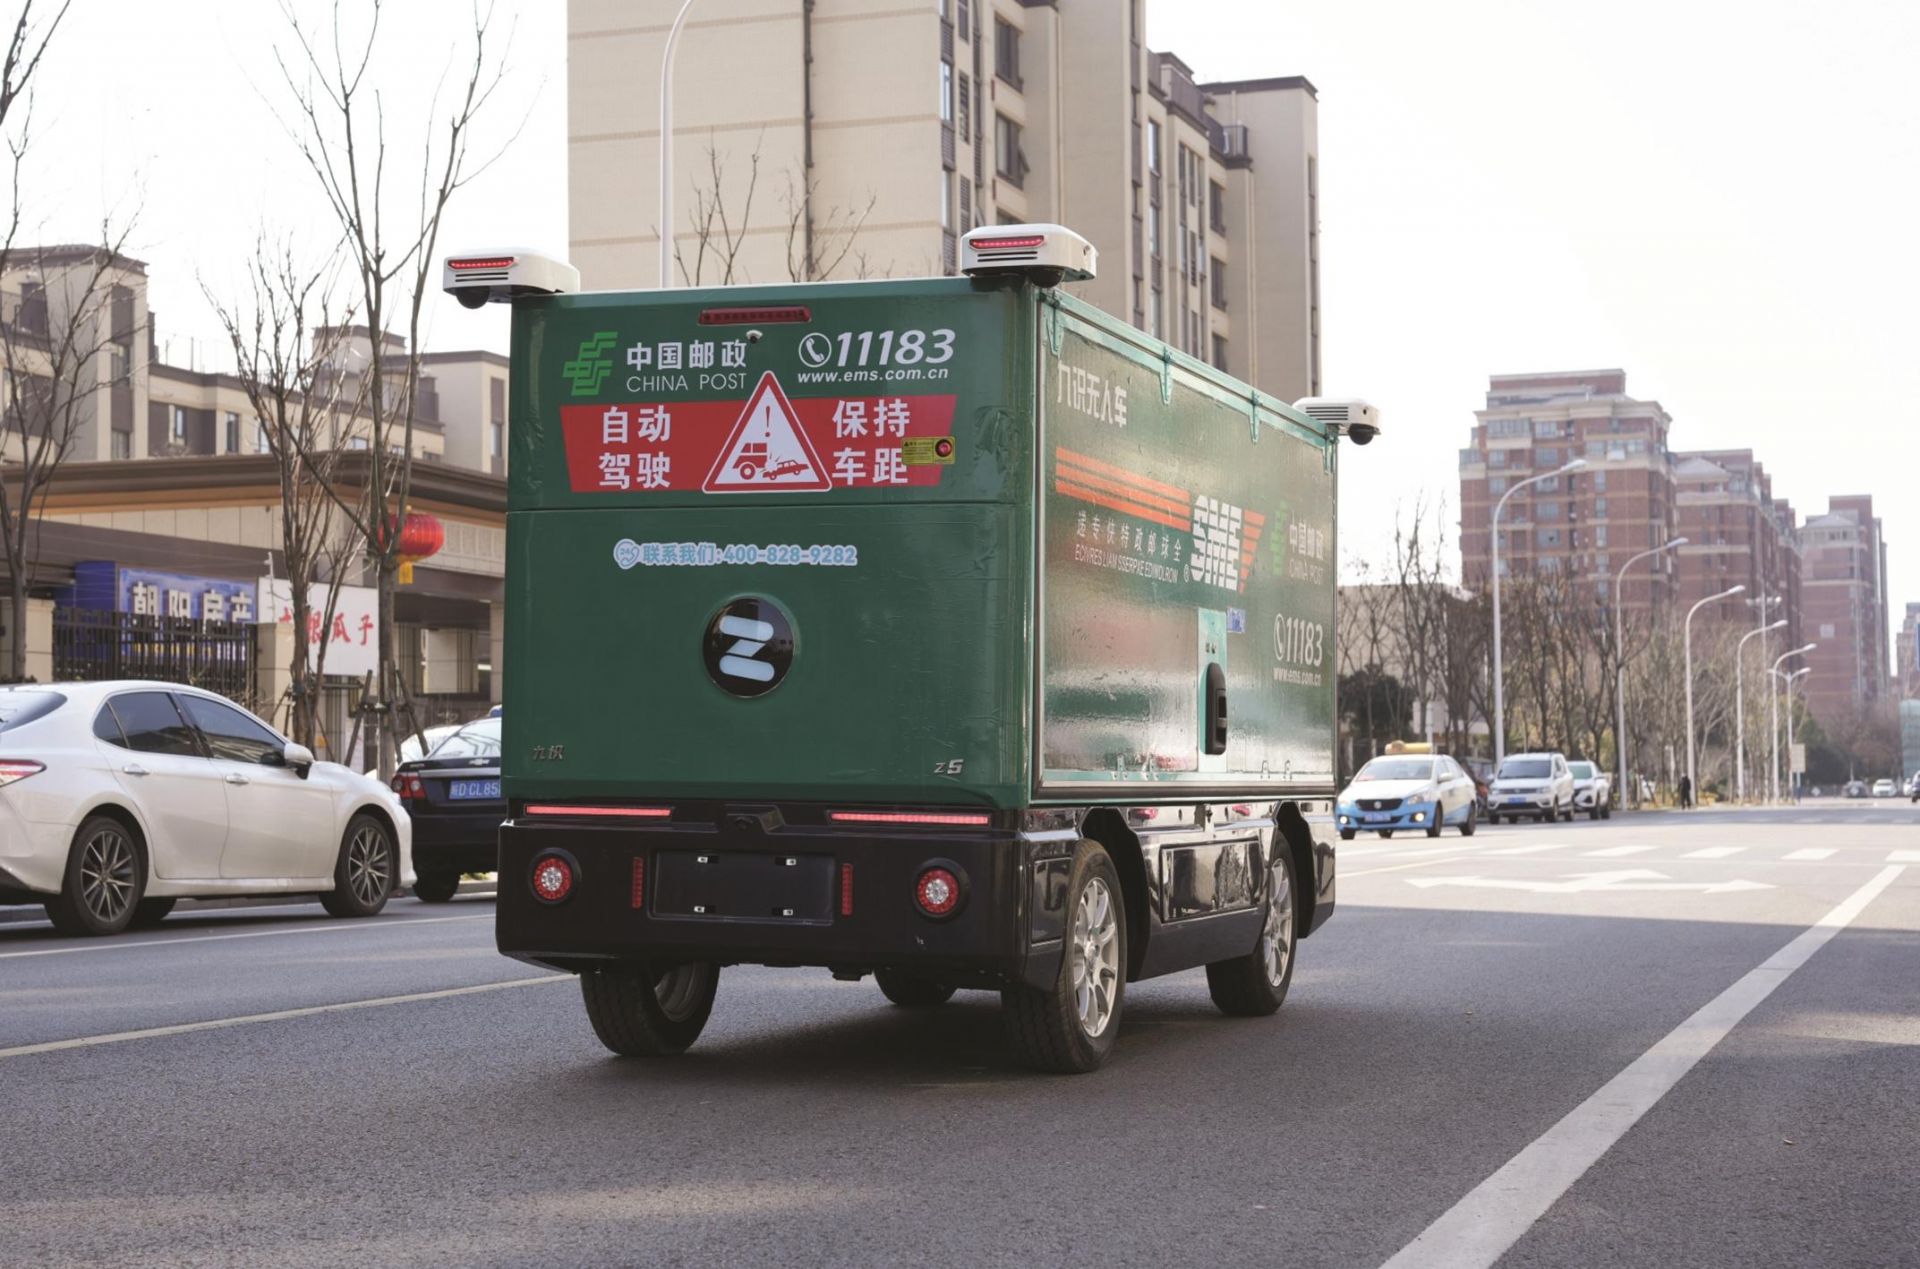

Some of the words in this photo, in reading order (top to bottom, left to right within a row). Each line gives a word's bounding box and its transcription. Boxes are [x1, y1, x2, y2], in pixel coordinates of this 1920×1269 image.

[626, 339, 747, 372] 中国邮政
[836, 328, 956, 368] 11183
[626, 374, 688, 393] CHINA
[700, 372, 747, 391] POST
[798, 366, 949, 384] www.ems.com.cn
[602, 405, 671, 444] 自动
[832, 399, 911, 439] 保持
[599, 452, 671, 490] 驾驶
[832, 447, 909, 486] 车距
[1286, 616, 1324, 667] 11183
